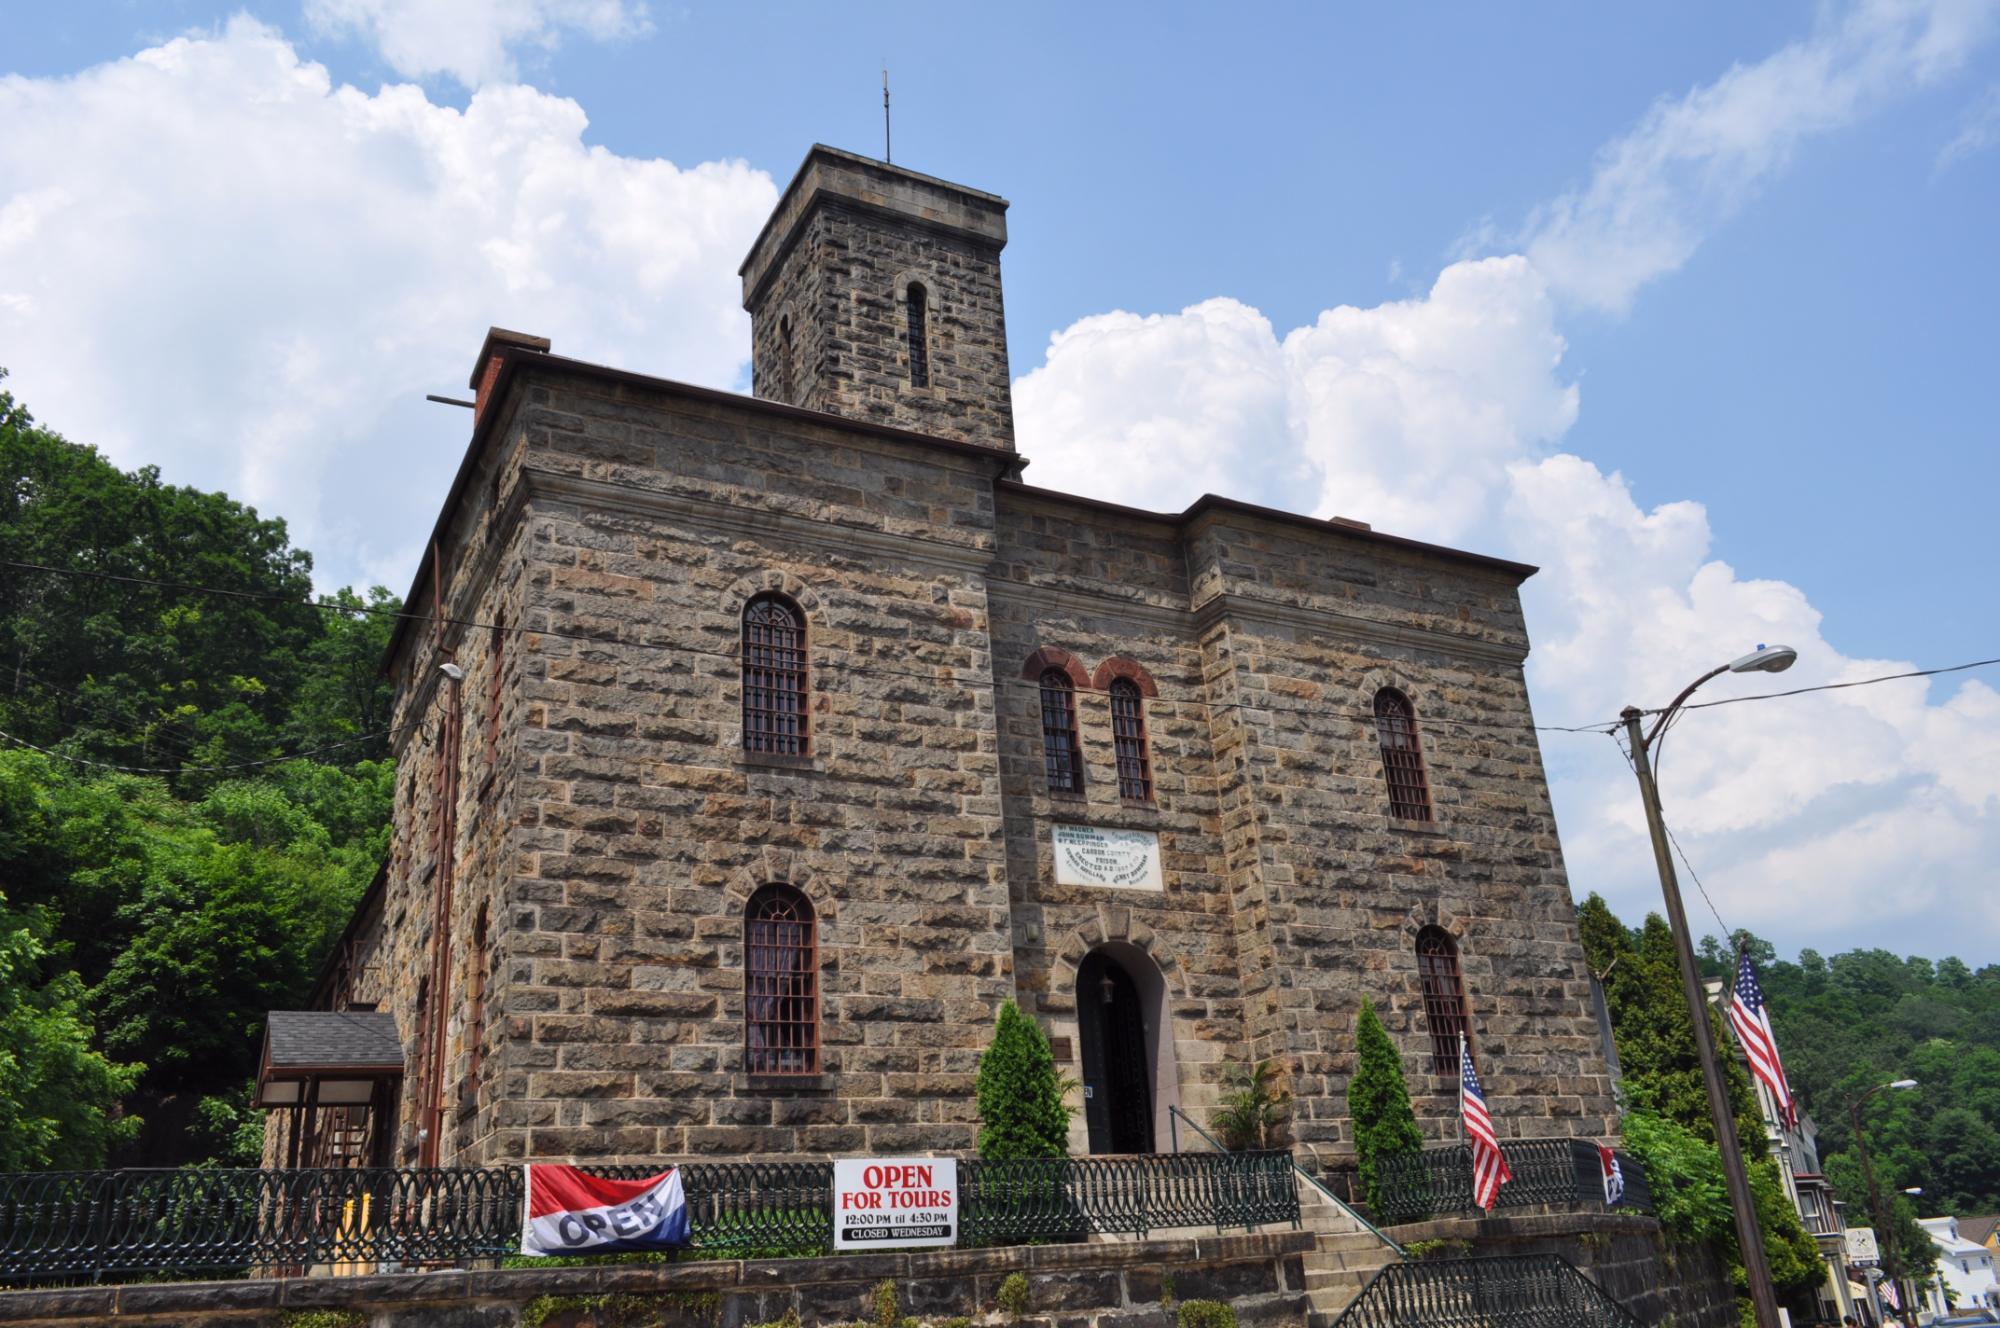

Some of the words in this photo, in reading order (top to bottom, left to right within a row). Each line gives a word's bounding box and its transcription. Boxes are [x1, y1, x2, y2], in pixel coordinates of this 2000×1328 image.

[1082, 847, 1105, 856] CARBON
[1096, 857, 1117, 865] PRISON
[863, 1165, 934, 1189] OPEN
[842, 1192, 882, 1210] FOR
[888, 1190, 952, 1209] TOURS
[559, 1192, 664, 1247] OPEN
[845, 1214, 874, 1225] 12:00
[876, 1214, 892, 1225] PM
[895, 1214, 905, 1224] til
[909, 1212, 932, 1224] 4:30
[934, 1213, 948, 1223] PM
[851, 1228, 889, 1239] CLOSED
[891, 1226, 944, 1238] WEDNESDAY
